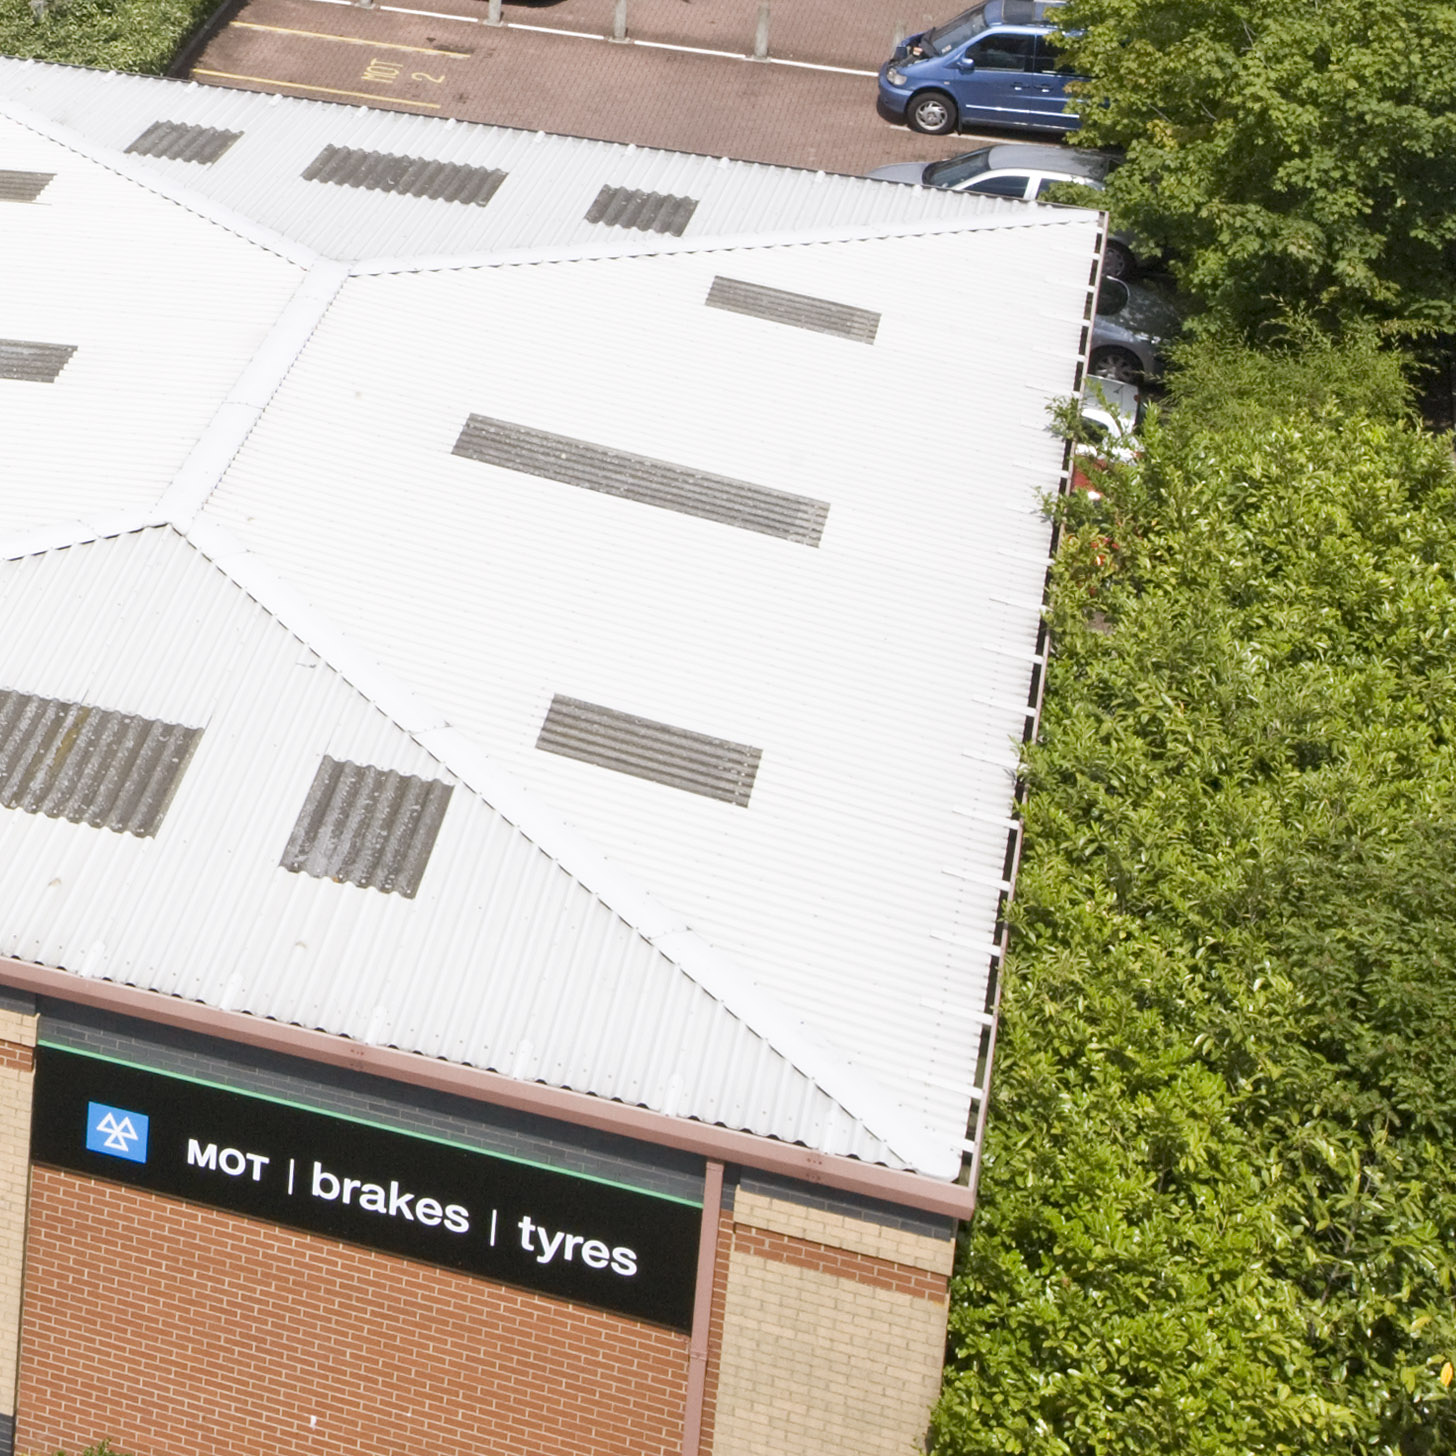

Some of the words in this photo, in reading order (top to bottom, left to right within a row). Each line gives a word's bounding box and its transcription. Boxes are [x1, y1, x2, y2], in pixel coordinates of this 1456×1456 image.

[187, 1138, 270, 1182] MOT
[311, 1161, 470, 1234] brakes
[517, 1215, 638, 1277] tyres
